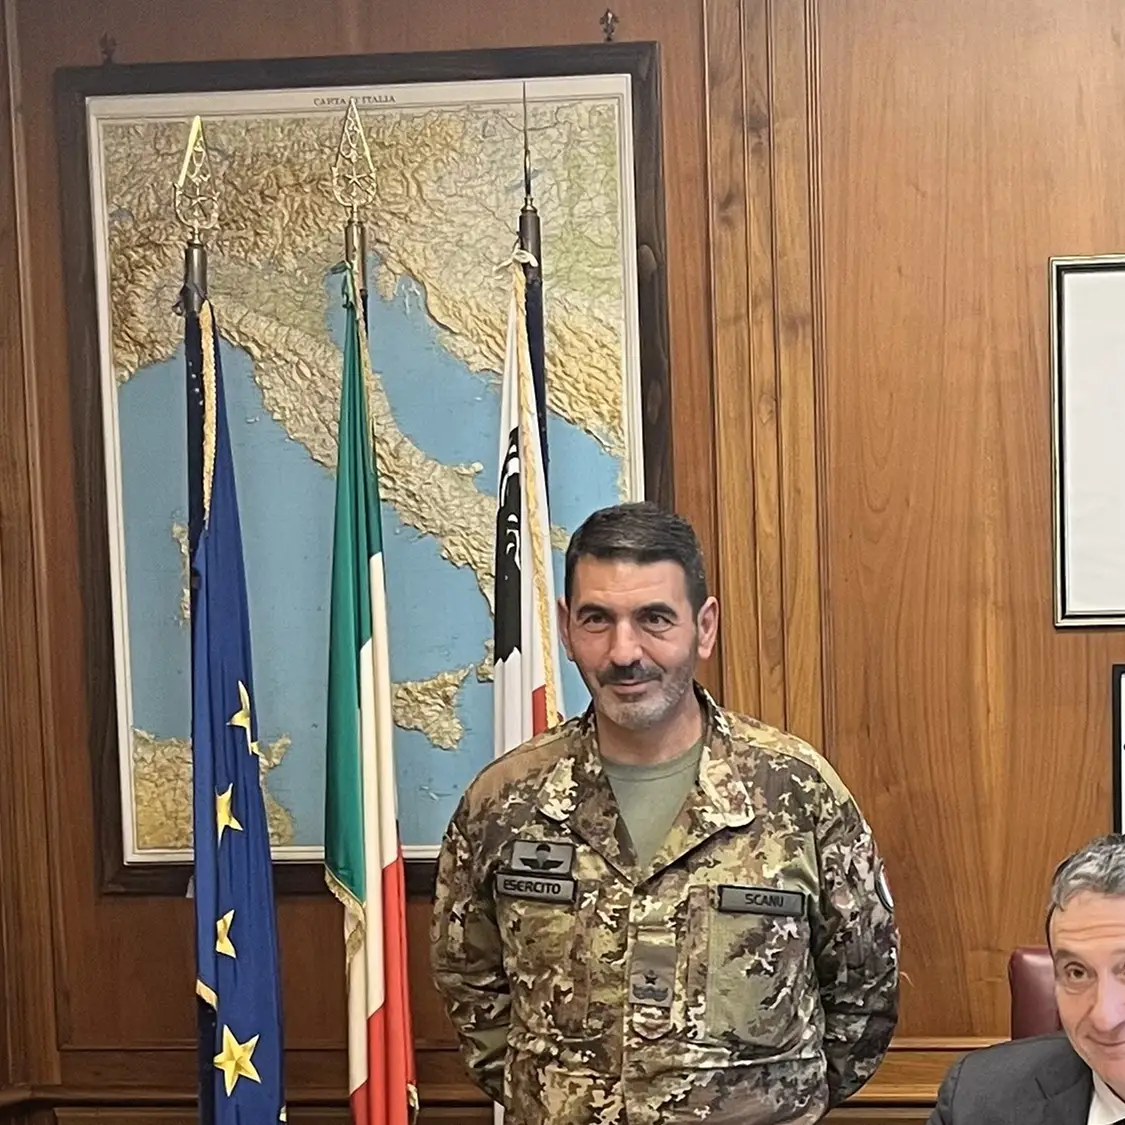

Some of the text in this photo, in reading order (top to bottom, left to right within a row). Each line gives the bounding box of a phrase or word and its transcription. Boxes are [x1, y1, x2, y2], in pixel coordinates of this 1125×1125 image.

[313, 97, 346, 106] CARTA
[502, 879, 561, 895] ESERCITO
[745, 893, 784, 908] SCANU
